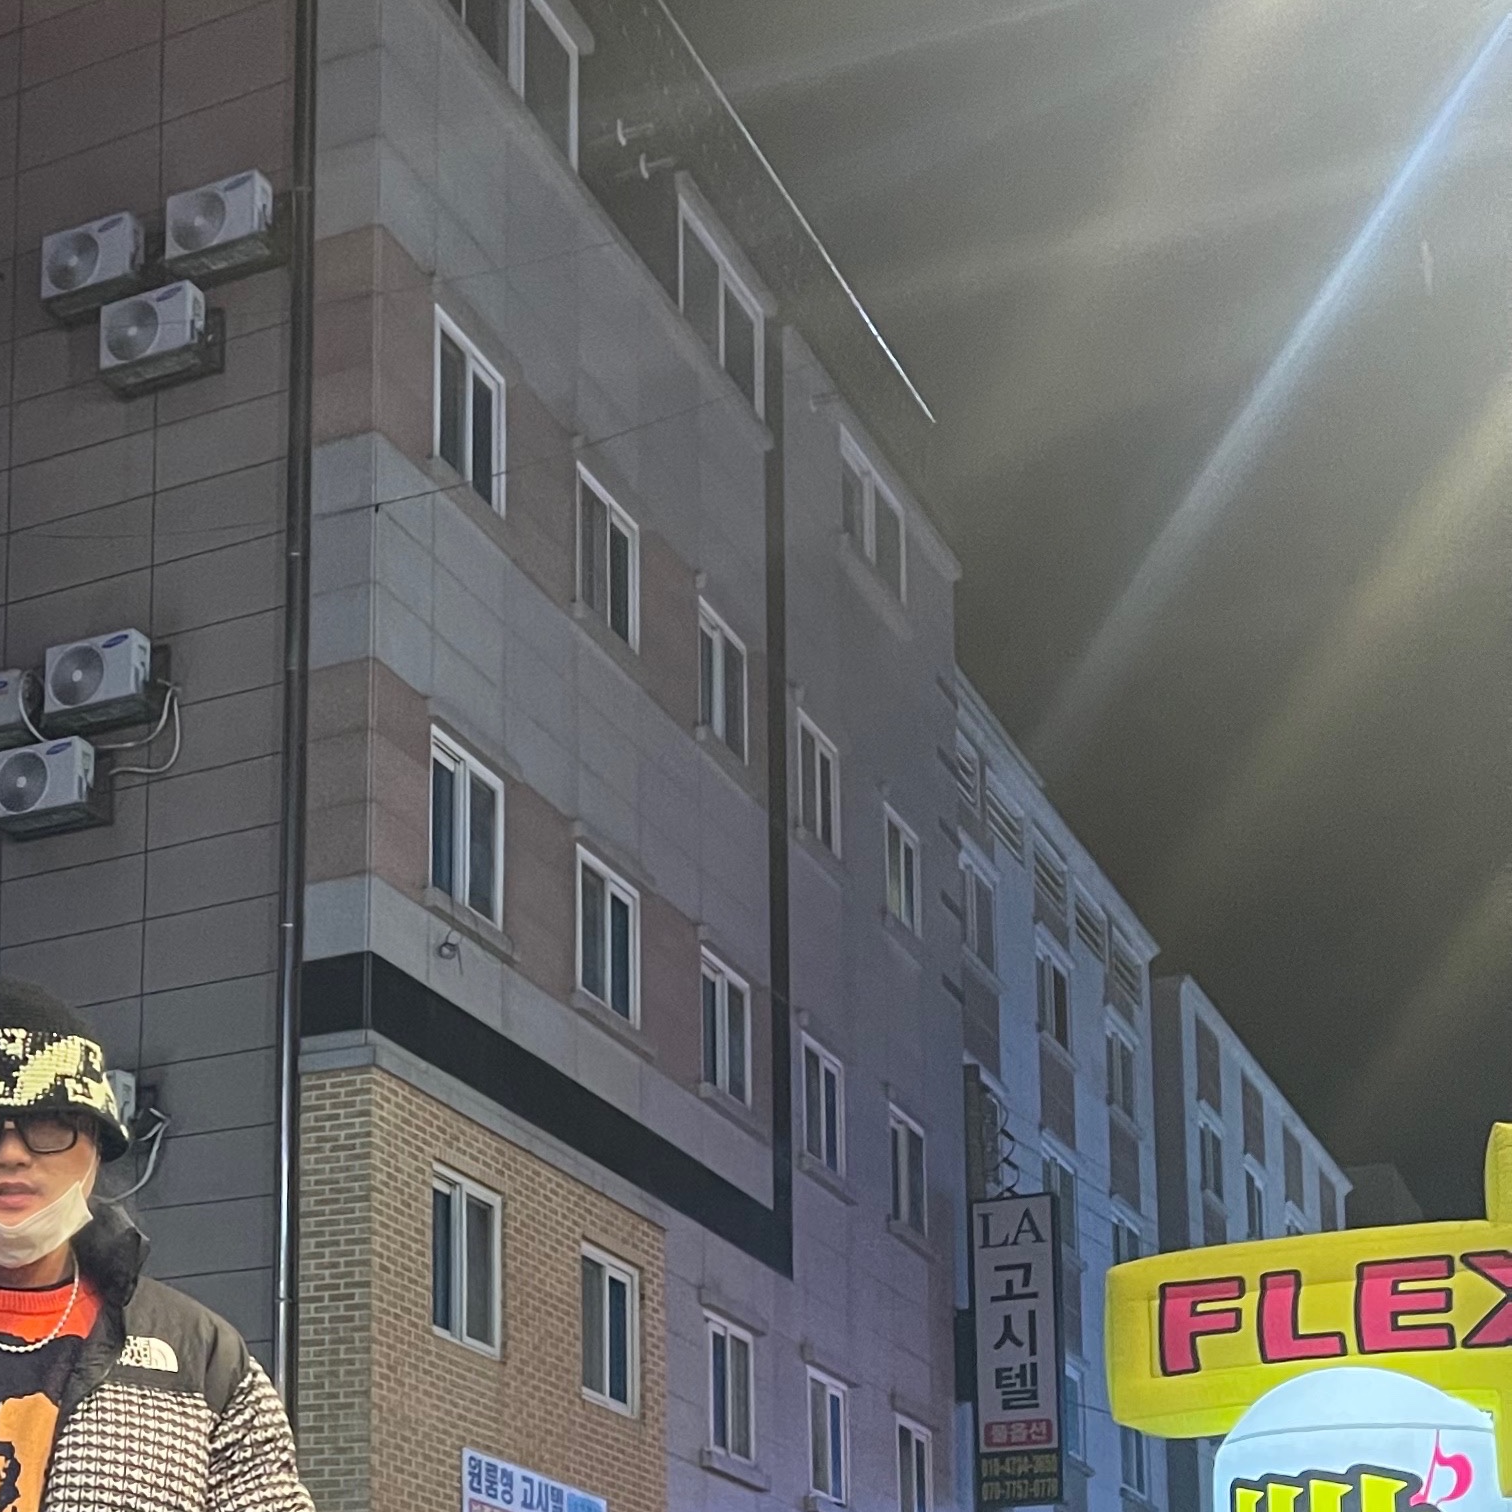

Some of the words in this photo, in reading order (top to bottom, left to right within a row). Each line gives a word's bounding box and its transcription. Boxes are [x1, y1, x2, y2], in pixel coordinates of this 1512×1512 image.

[977, 1207, 1047, 1250] LA
[990, 1261, 1040, 1411] 고시텔
[468, 1455, 514, 1505] 원룸형
